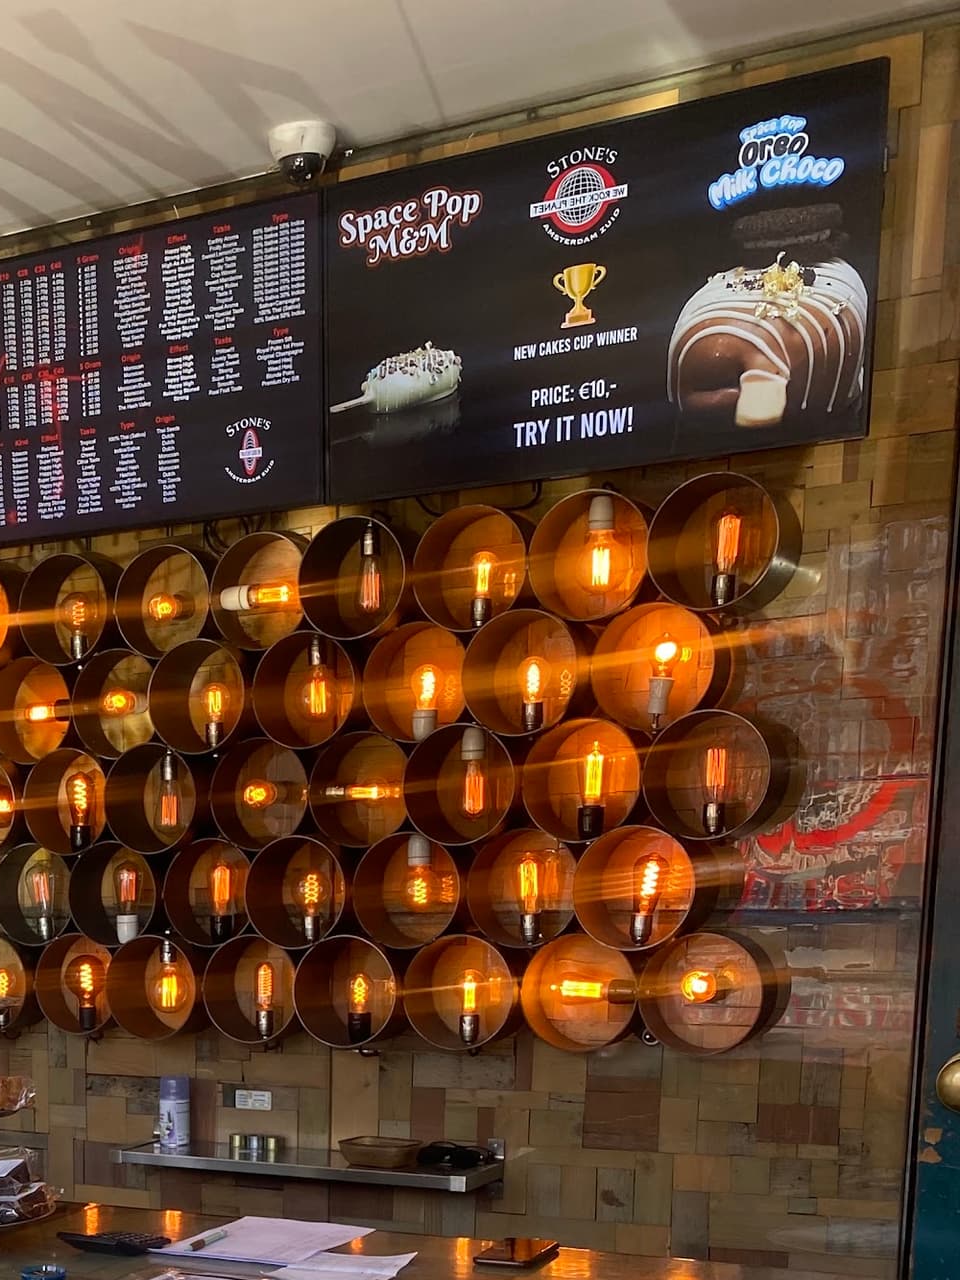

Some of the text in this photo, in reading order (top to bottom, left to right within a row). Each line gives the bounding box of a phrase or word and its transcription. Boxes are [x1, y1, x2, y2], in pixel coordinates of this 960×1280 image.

[546, 146, 618, 179] STONE'S
[710, 168, 755, 207] Milk
[340, 189, 481, 244] Space Pop
[542, 207, 621, 246] AMSTERDAM ZUID
[369, 215, 453, 264] M&M
[513, 326, 638, 361] NEW CAKES CUP WINNER
[531, 378, 617, 408] PRICE: €10,-
[226, 417, 272, 437] STONE'S
[513, 406, 634, 448] TRY IT NOW!
